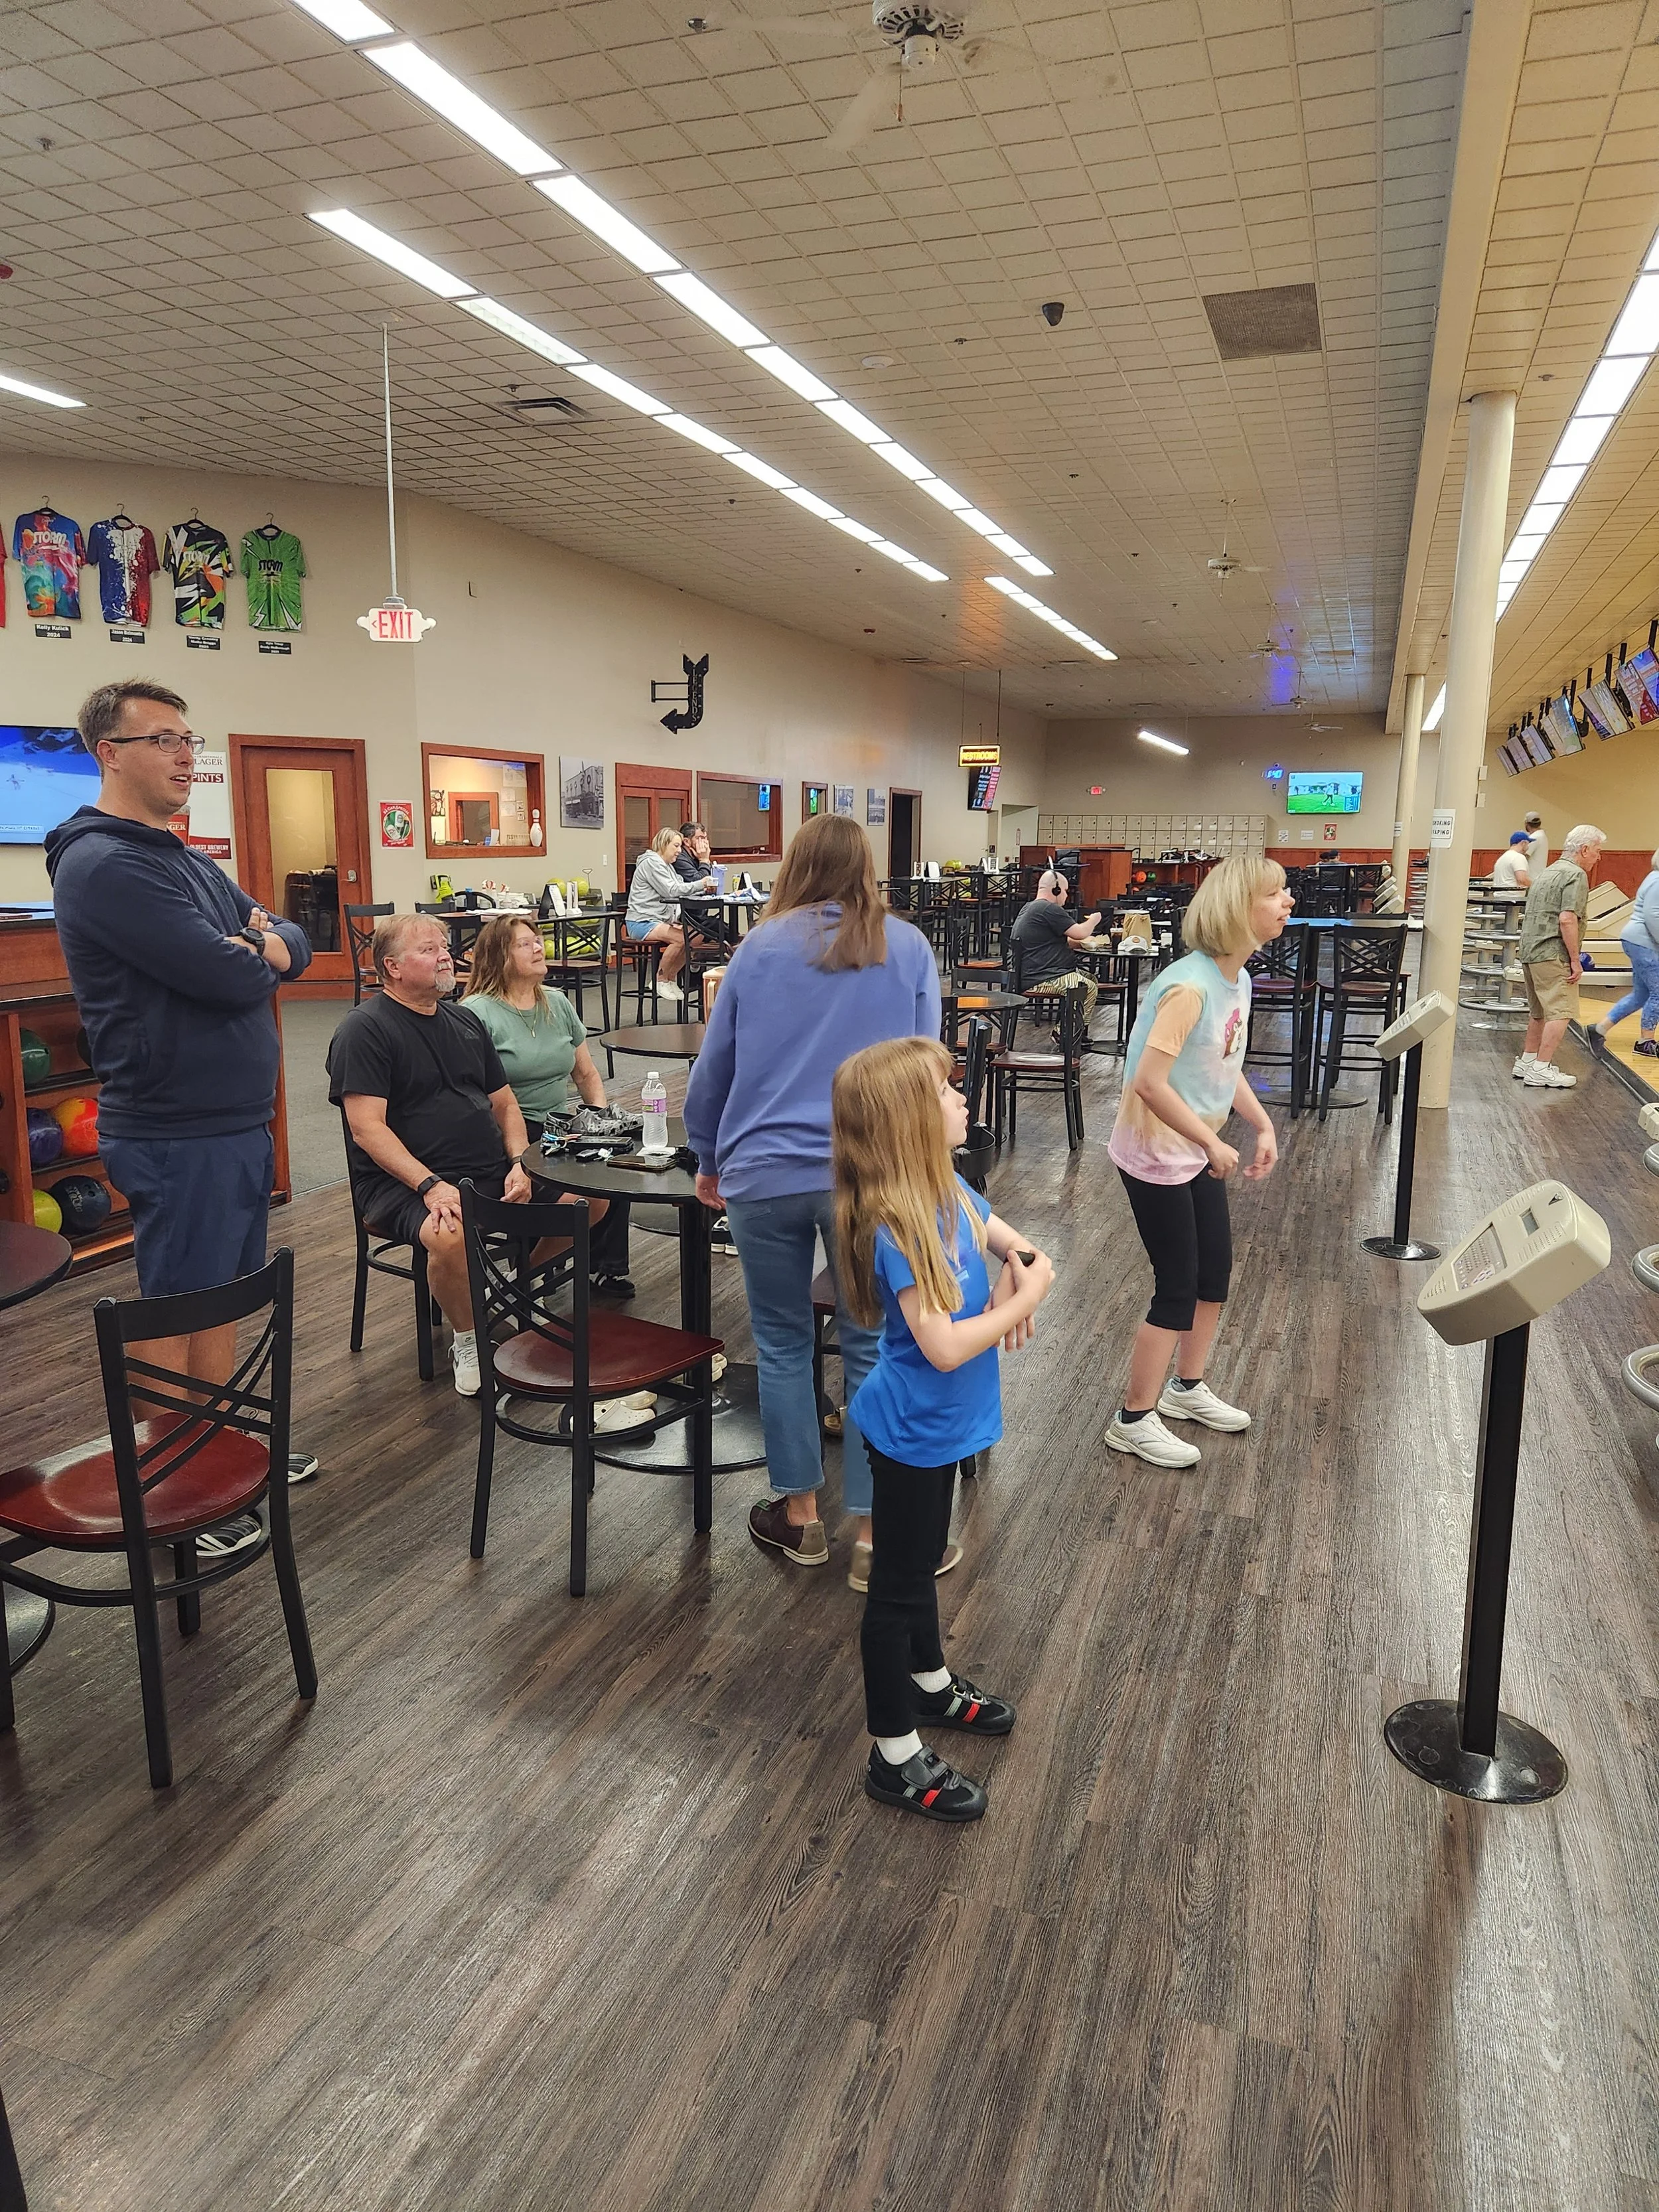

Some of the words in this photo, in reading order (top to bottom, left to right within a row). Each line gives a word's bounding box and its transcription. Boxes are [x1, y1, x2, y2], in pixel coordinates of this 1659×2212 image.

[33, 531, 66, 546] STORM
[378, 611, 413, 639] EXIT
[962, 751, 998, 761] RESTROOMS
